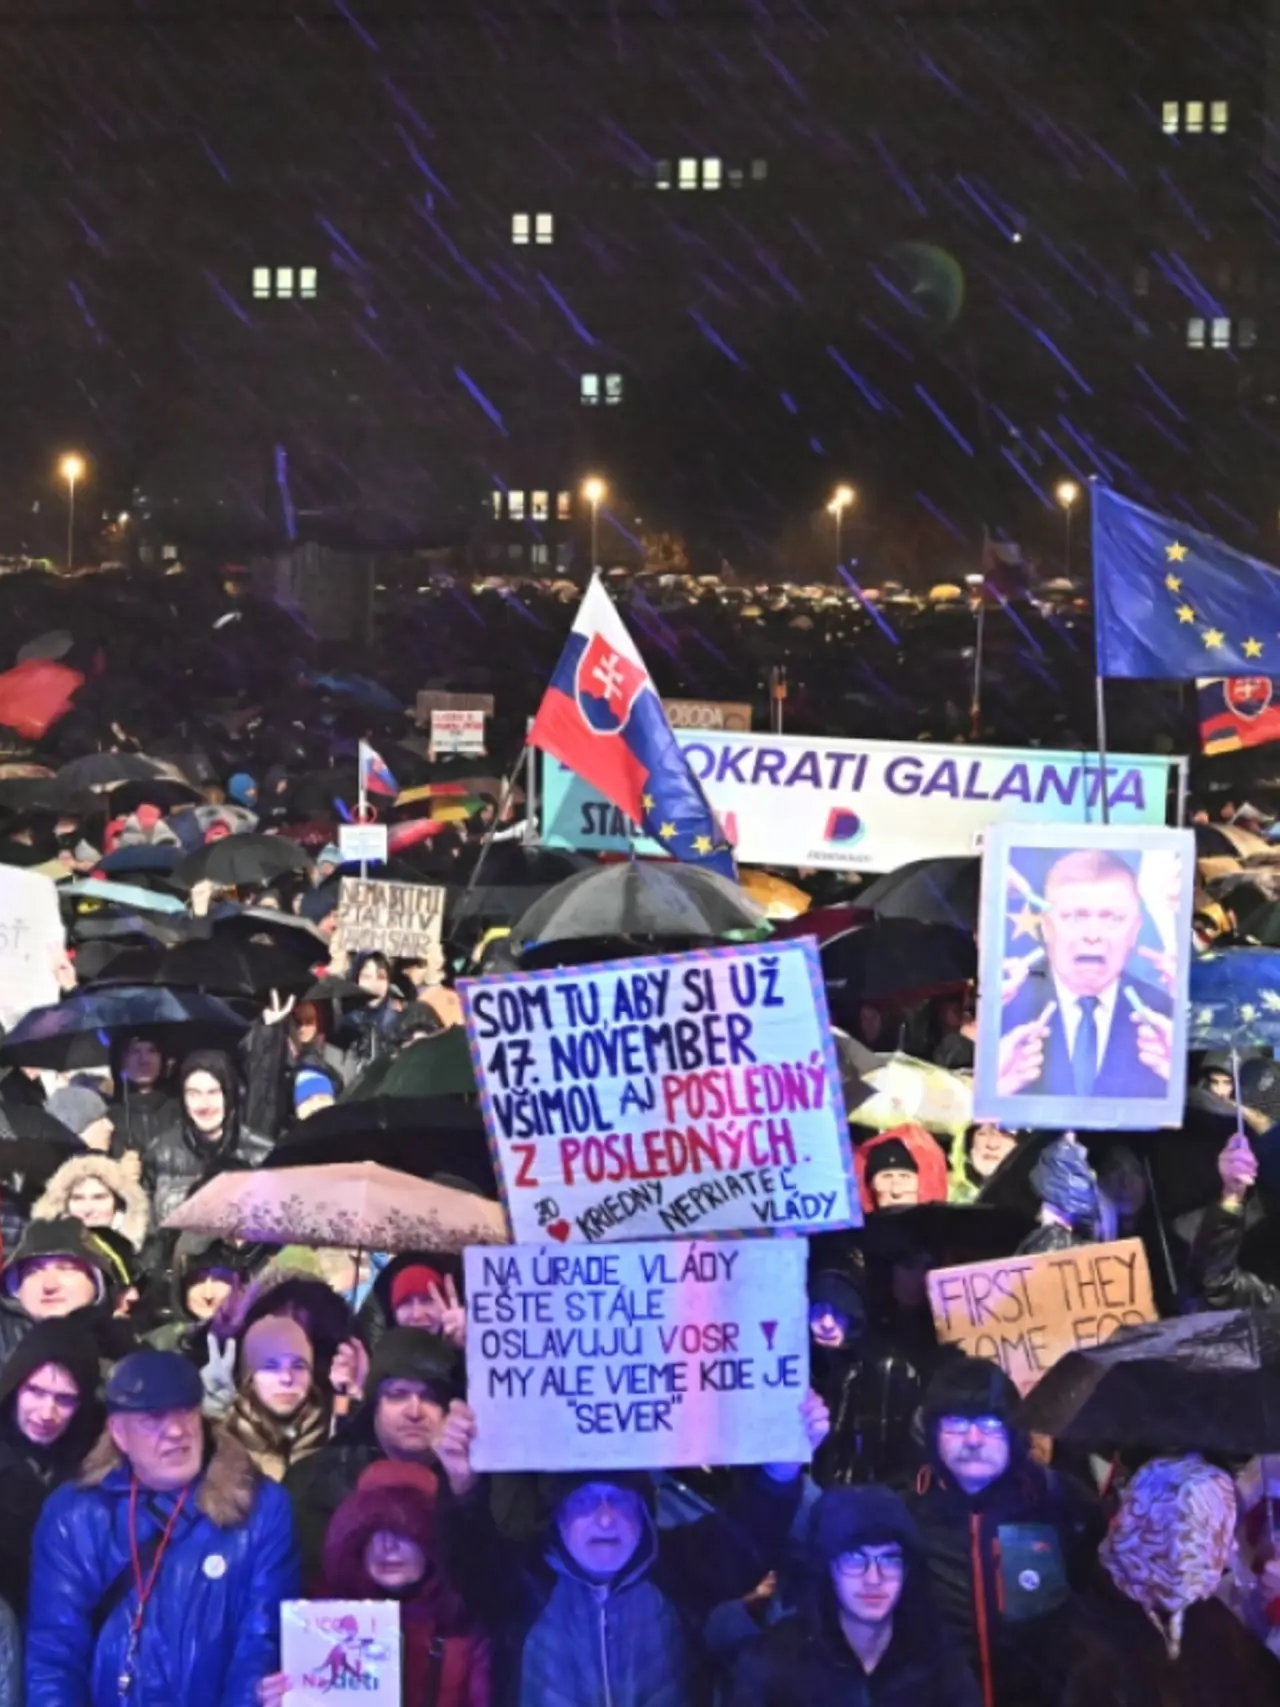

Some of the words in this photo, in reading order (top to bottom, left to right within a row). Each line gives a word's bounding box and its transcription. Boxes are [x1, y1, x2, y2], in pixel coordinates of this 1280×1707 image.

[883, 755, 1145, 811] GALANTA
[472, 985, 552, 1038] SOM
[614, 969, 670, 1025] ABY
[682, 968, 717, 1014] SI
[729, 956, 784, 1008] UŽ
[487, 1038, 540, 1088] 17.
[551, 1013, 757, 1082] NOVEMBER
[492, 1083, 613, 1140] VŠIMOL
[620, 1076, 656, 1116] AJ
[663, 1050, 826, 1123] POSLEDNÝ
[510, 1143, 538, 1188] Z
[560, 1118, 812, 1187] POSLEDNÝCH.
[751, 1191, 837, 1225] VLÁDY
[483, 1256, 522, 1287] NA
[533, 1248, 620, 1286] ÚRADE
[640, 1243, 739, 1285] VLÁDY
[937, 1266, 1034, 1330] FIRST
[1049, 1252, 1137, 1311] THEY
[472, 1284, 554, 1324] EŠTE
[566, 1285, 665, 1323] STÁLE
[658, 1322, 740, 1355] VOSR
[956, 1325, 1048, 1374] OME
[488, 1366, 534, 1398] MY
[540, 1365, 595, 1397] ALE
[605, 1362, 688, 1395] VIEME
[700, 1359, 754, 1392] KDE
[763, 1355, 801, 1388] JE
